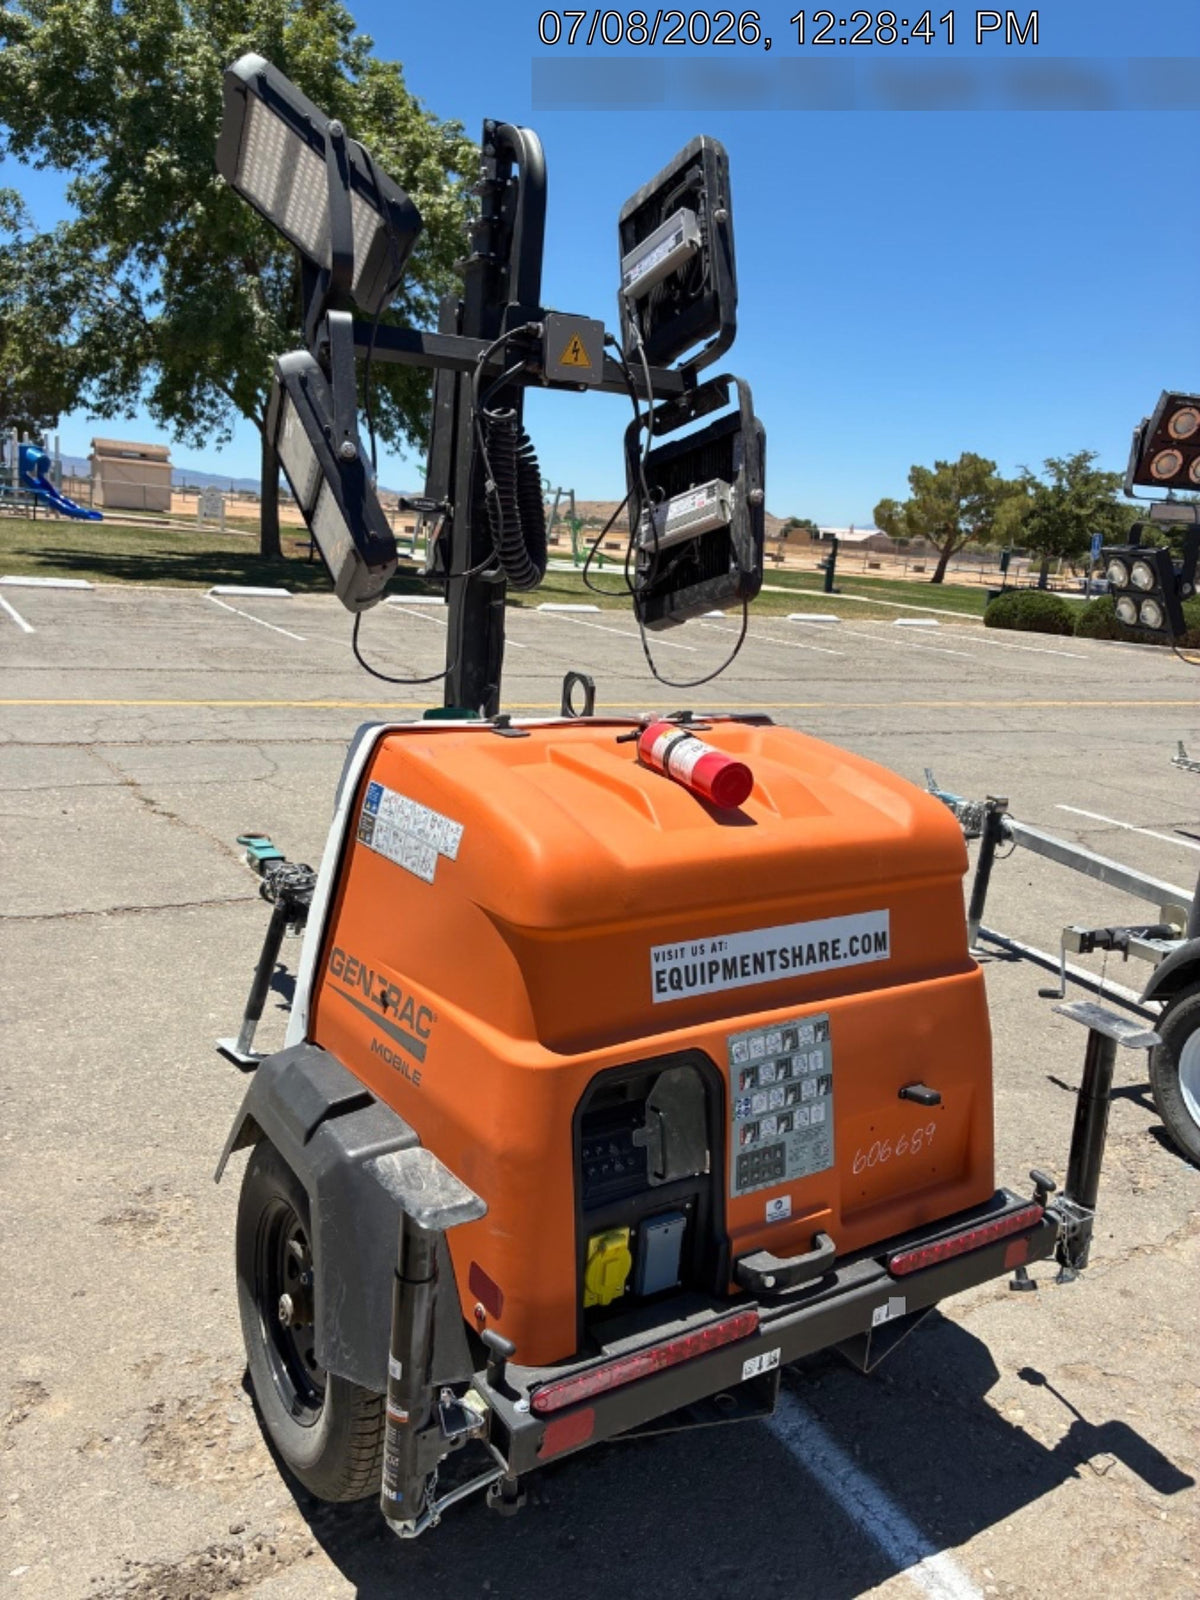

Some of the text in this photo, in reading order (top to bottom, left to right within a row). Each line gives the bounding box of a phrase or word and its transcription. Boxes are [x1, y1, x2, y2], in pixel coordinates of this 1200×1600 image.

[653, 940, 728, 963] VISIT US AT:
[655, 931, 888, 994] EQUIPMENTSHARE.COM
[370, 1037, 422, 1087] MOBILE
[852, 1121, 937, 1175] 606689
